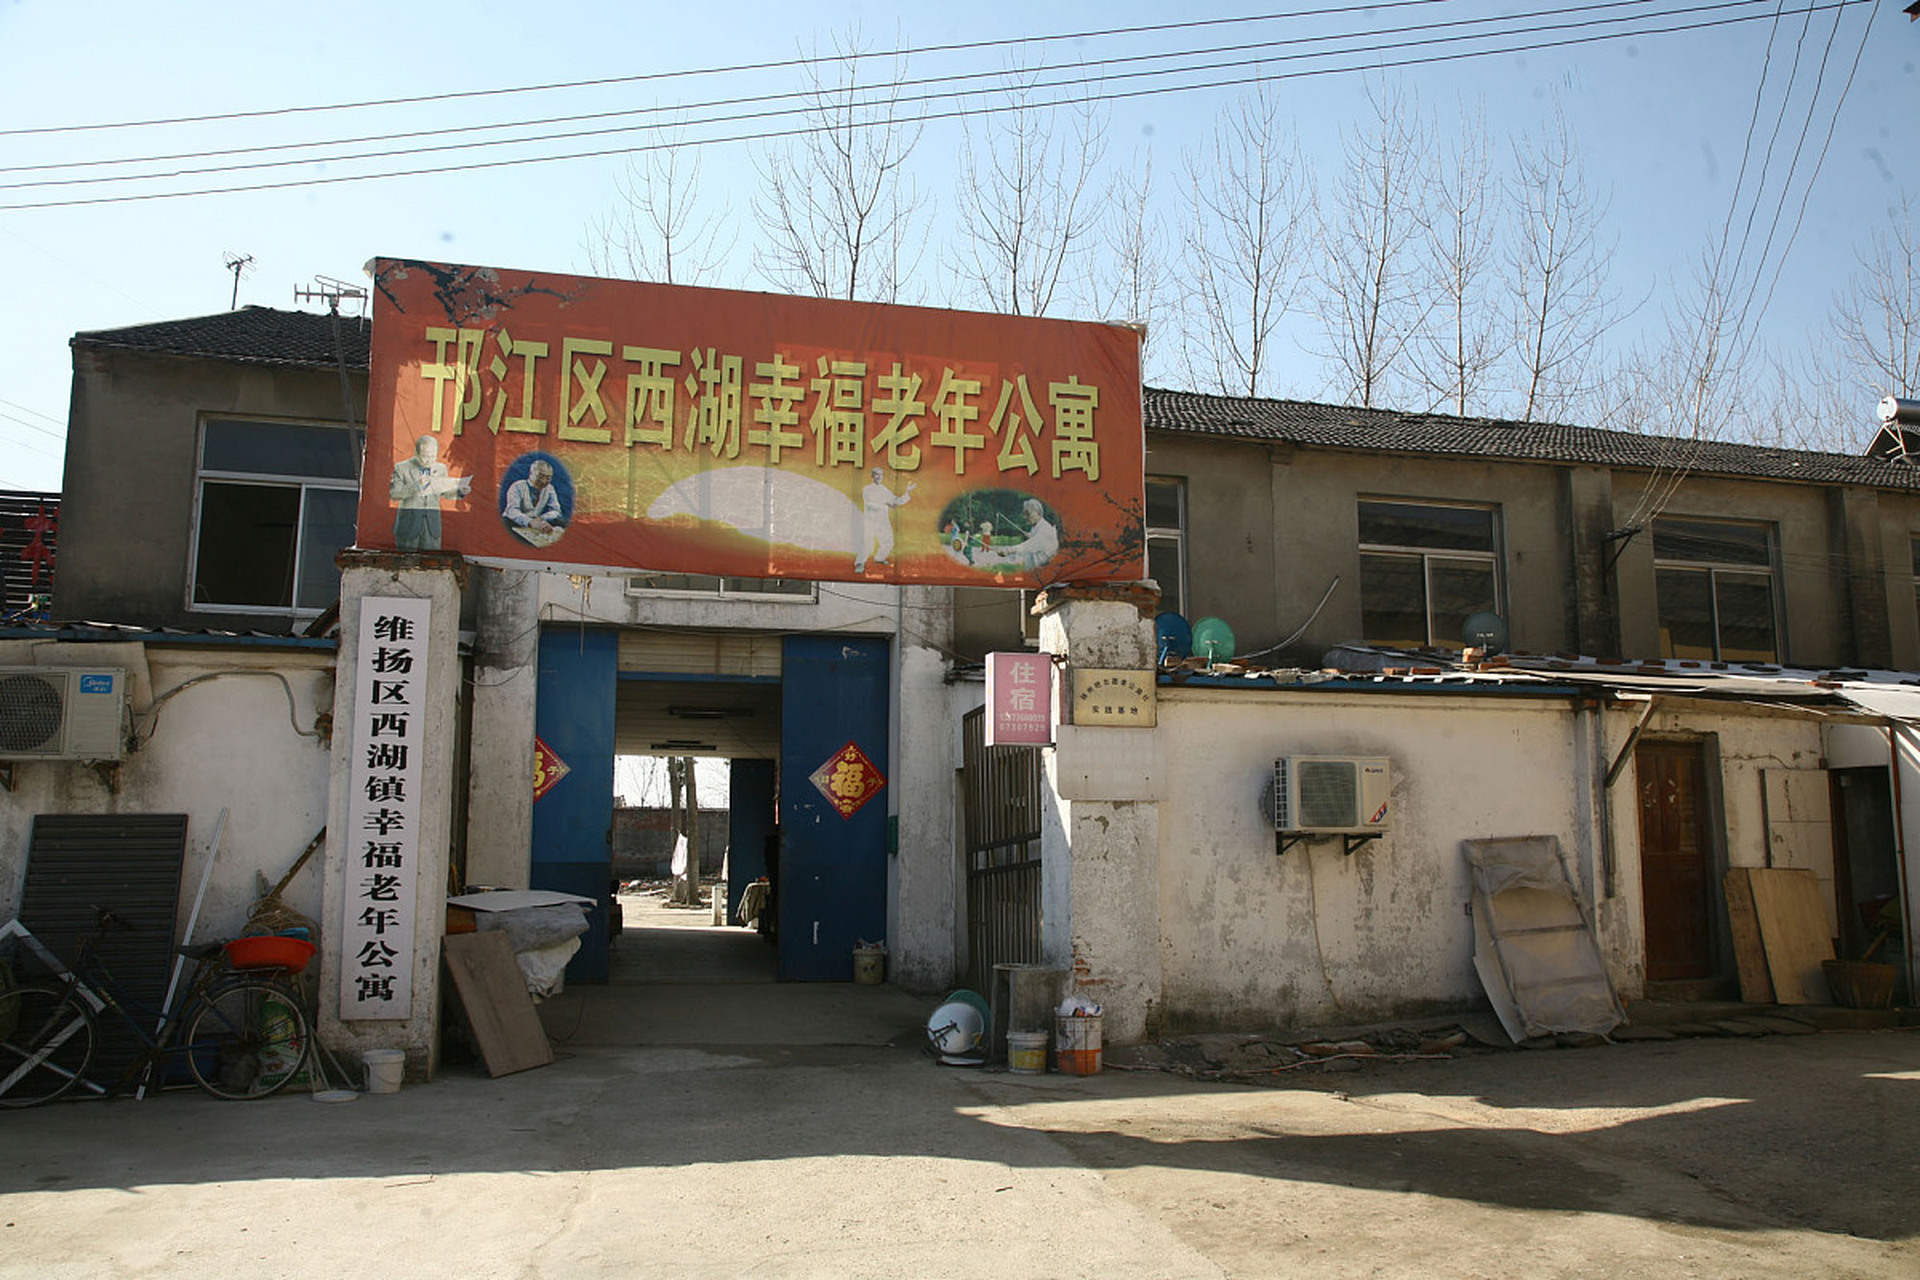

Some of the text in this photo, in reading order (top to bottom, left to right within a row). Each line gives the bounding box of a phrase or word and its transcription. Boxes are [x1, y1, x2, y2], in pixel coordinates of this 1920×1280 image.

[420, 325, 1101, 484] 邗江区西湖幸福老年公寓
[1009, 661, 1036, 711] 住宿
[355, 614, 415, 1002] 维扬区西湖镇幸福老年公寓
[830, 760, 865, 798] 福
